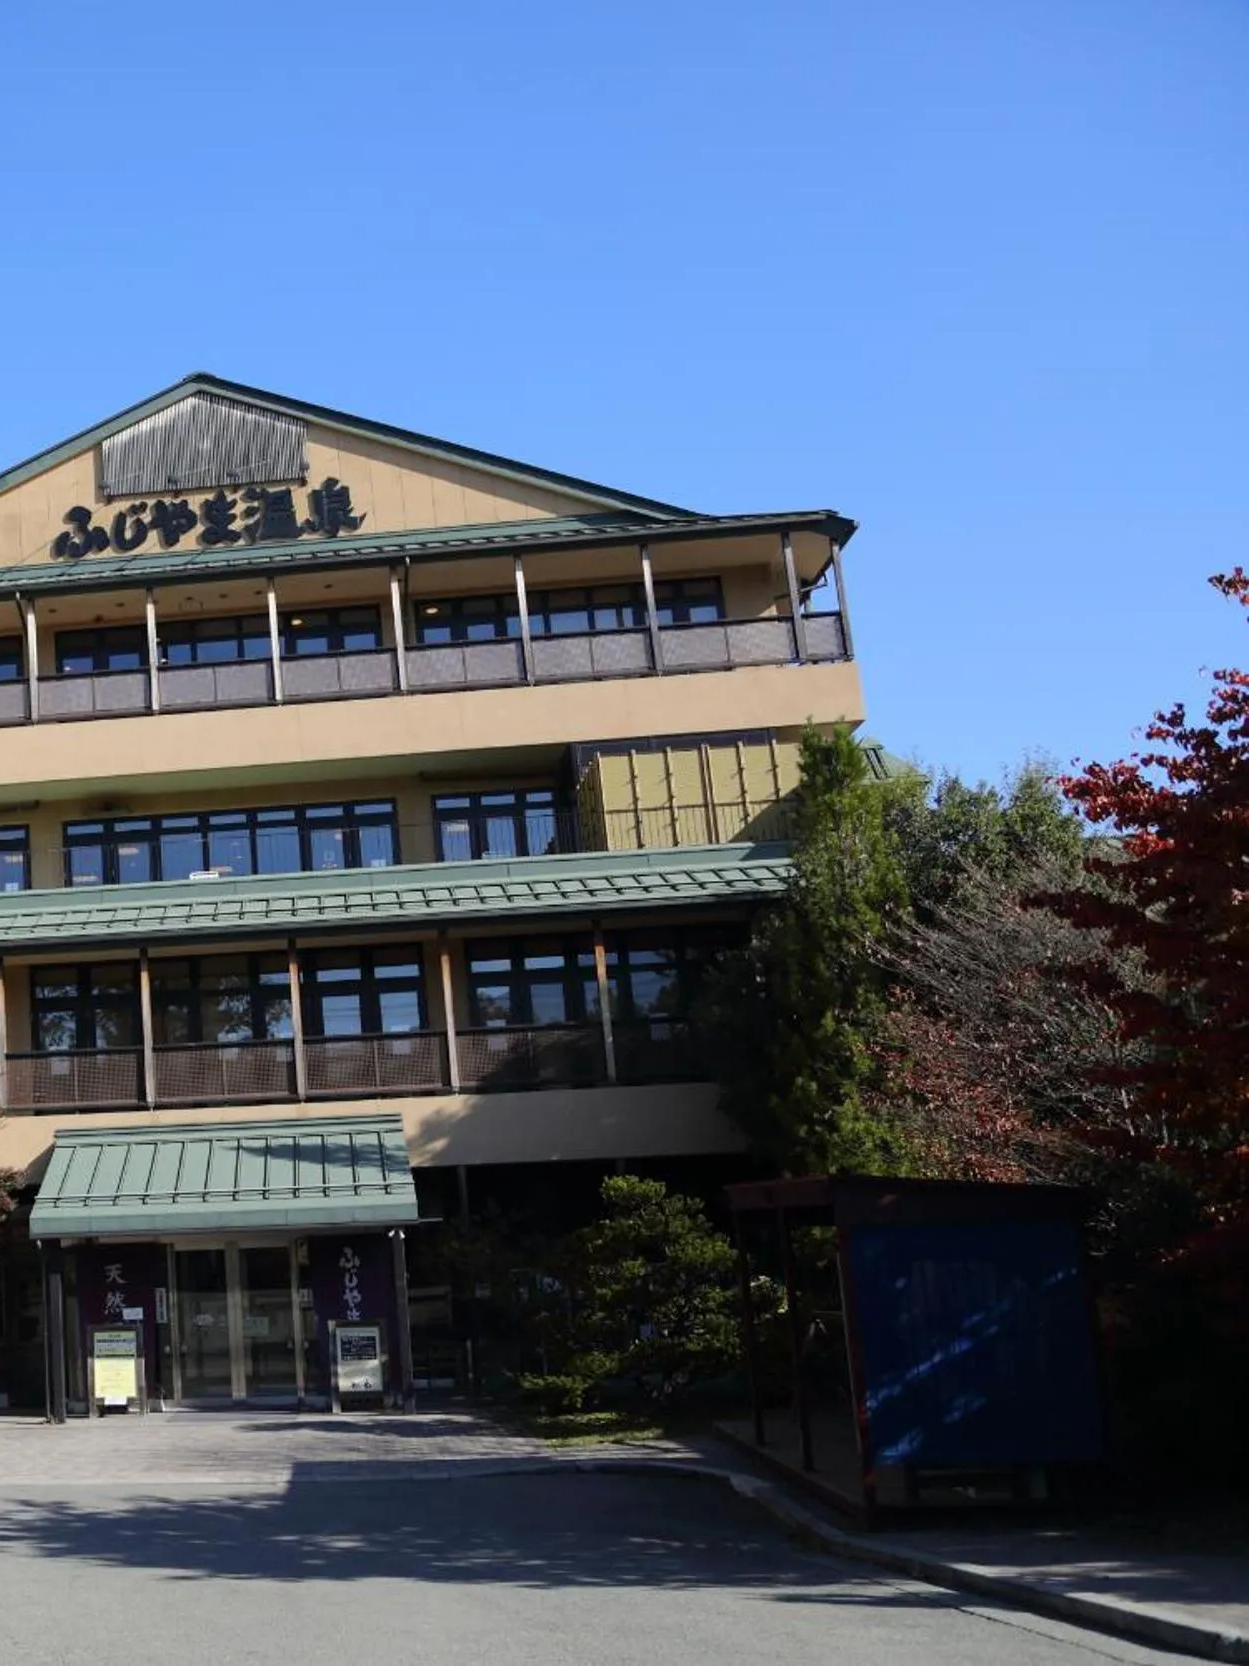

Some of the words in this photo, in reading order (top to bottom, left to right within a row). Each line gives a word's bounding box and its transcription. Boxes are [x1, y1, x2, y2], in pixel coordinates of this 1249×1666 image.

[52, 476, 366, 559] ふじやま温泉
